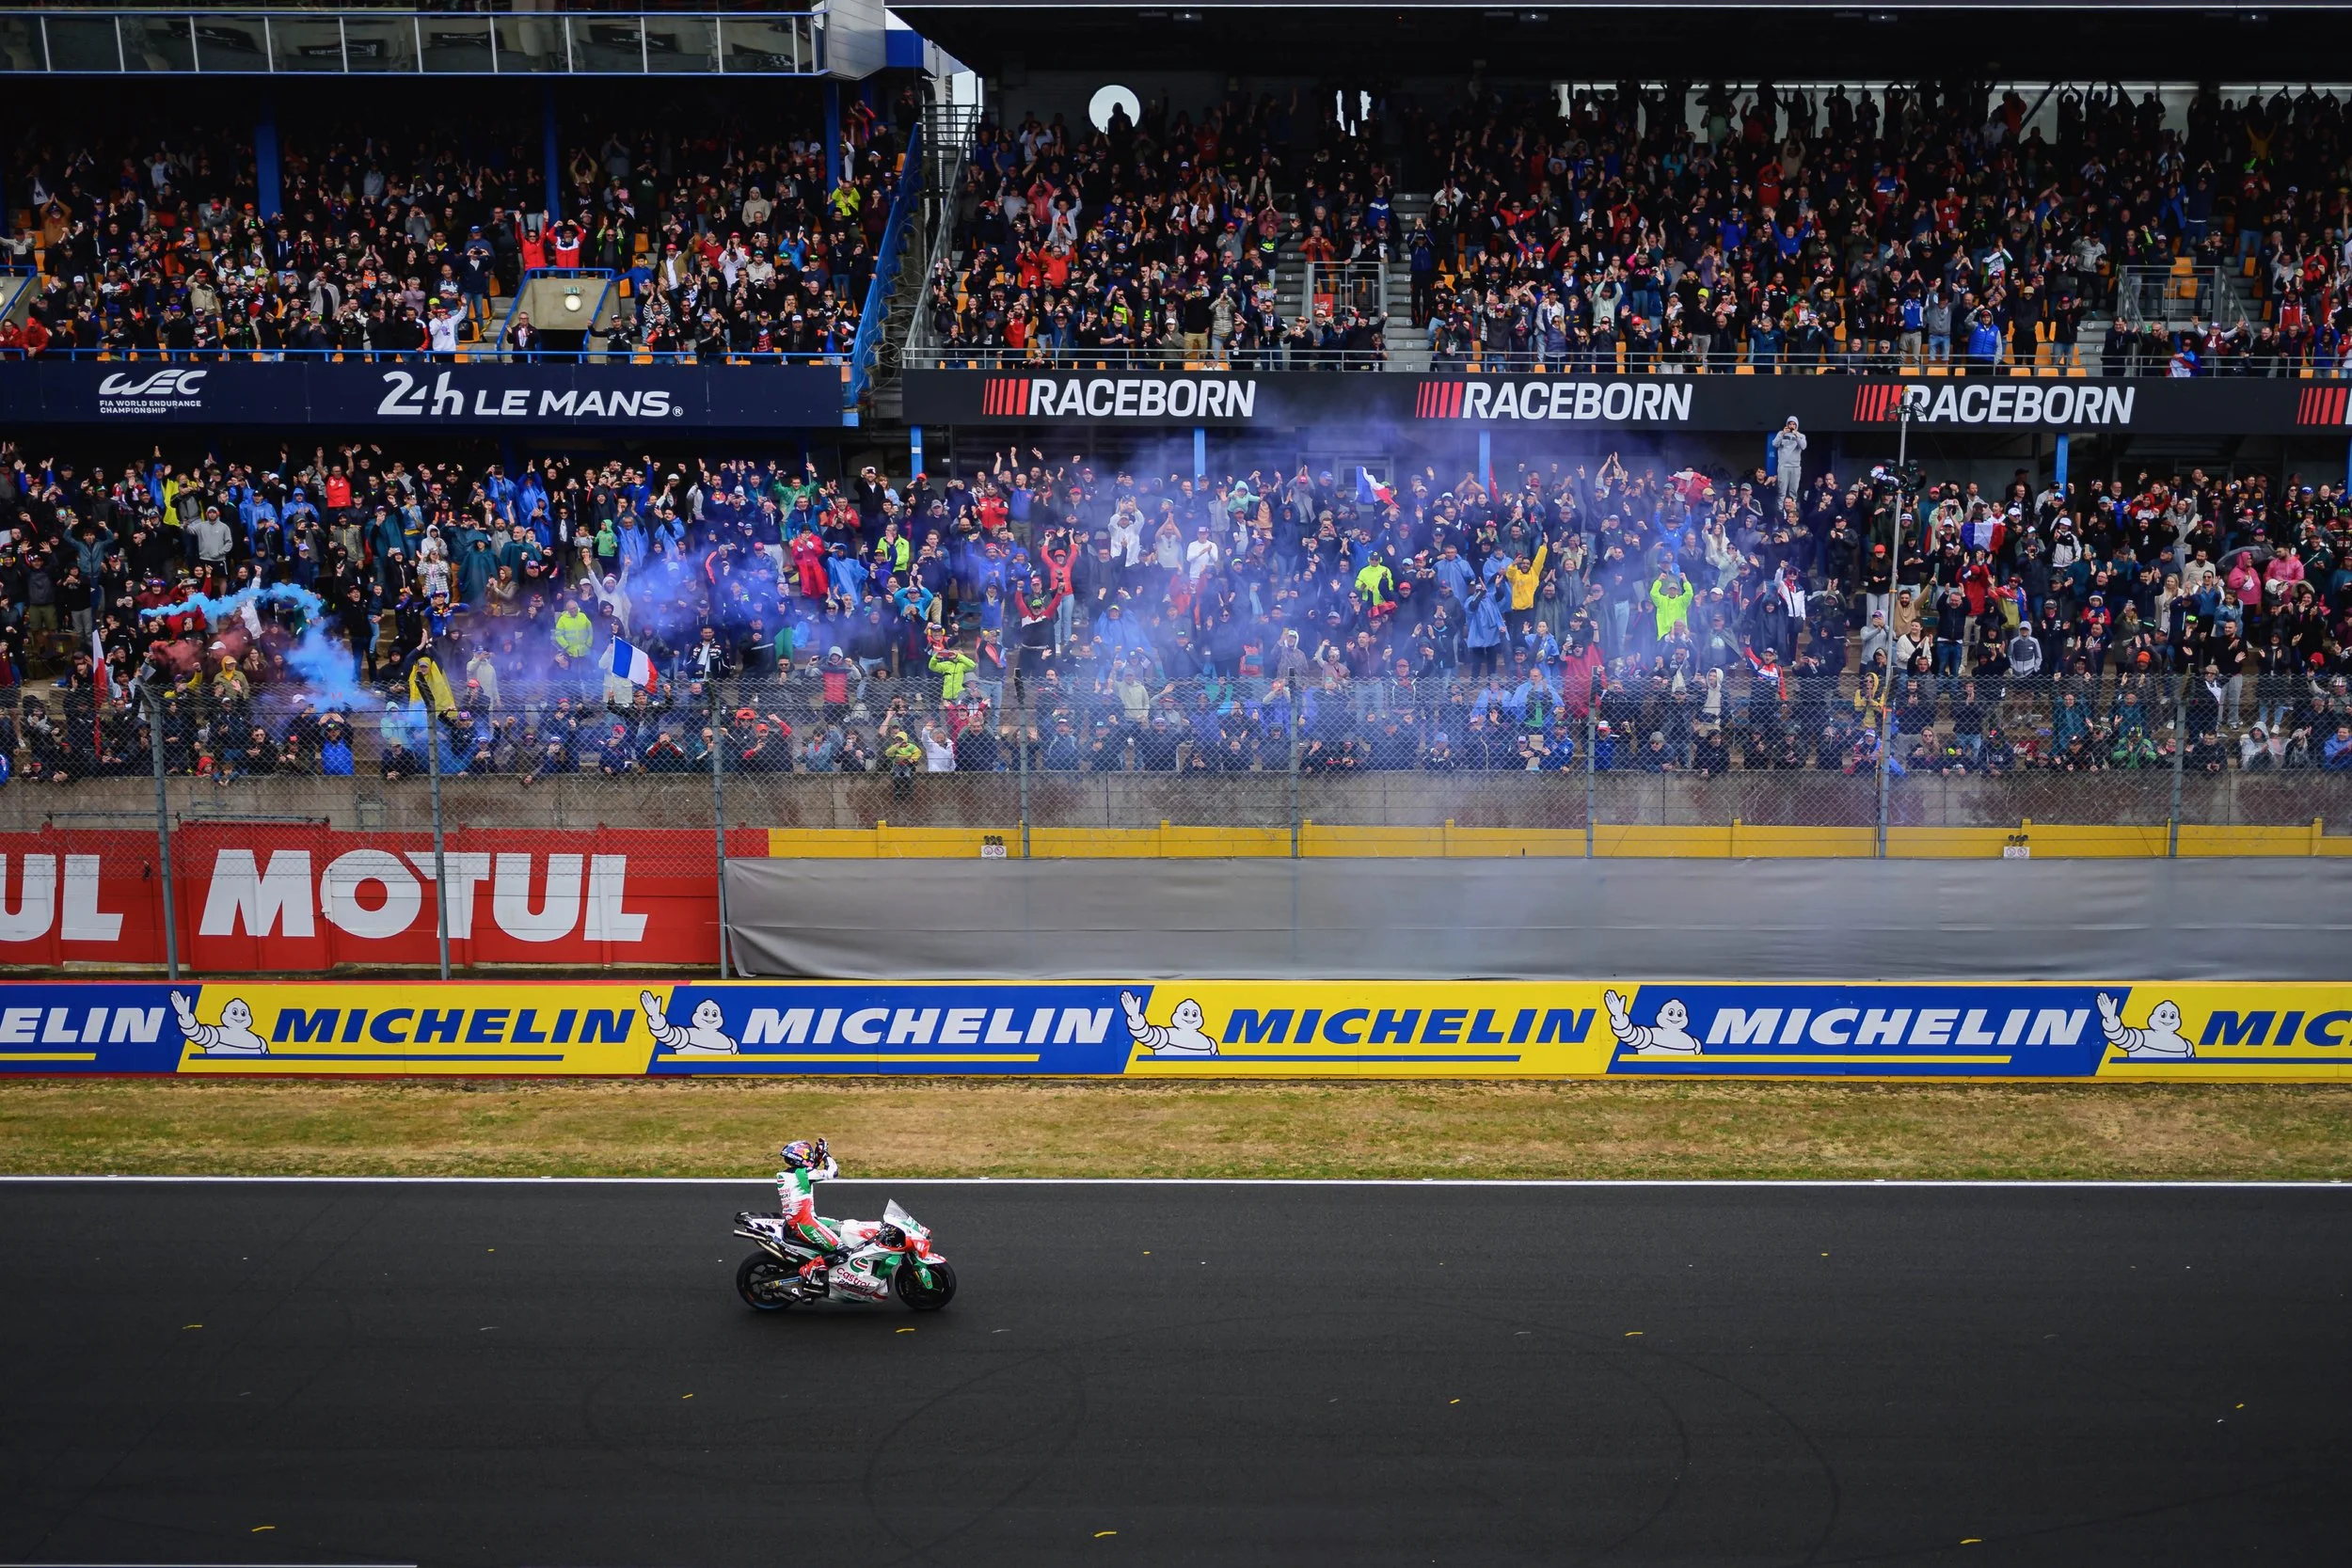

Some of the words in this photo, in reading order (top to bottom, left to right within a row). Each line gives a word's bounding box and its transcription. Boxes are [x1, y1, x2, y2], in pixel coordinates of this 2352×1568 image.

[99, 370, 207, 395] WEC
[1029, 379, 1256, 417] RACEBORN
[1463, 382, 1693, 420] RACEBORN
[474, 390, 531, 416] LE
[1901, 384, 2136, 424] RACEBORN
[199, 848, 648, 942] MOTUL
[272, 1008, 635, 1043] MICHELIN
[740, 1007, 1114, 1044] MICHELIN
[1222, 1008, 1597, 1044] MICHELIN
[1706, 1008, 2090, 1045] MICHELIN
[836, 1267, 871, 1288] Castrol
